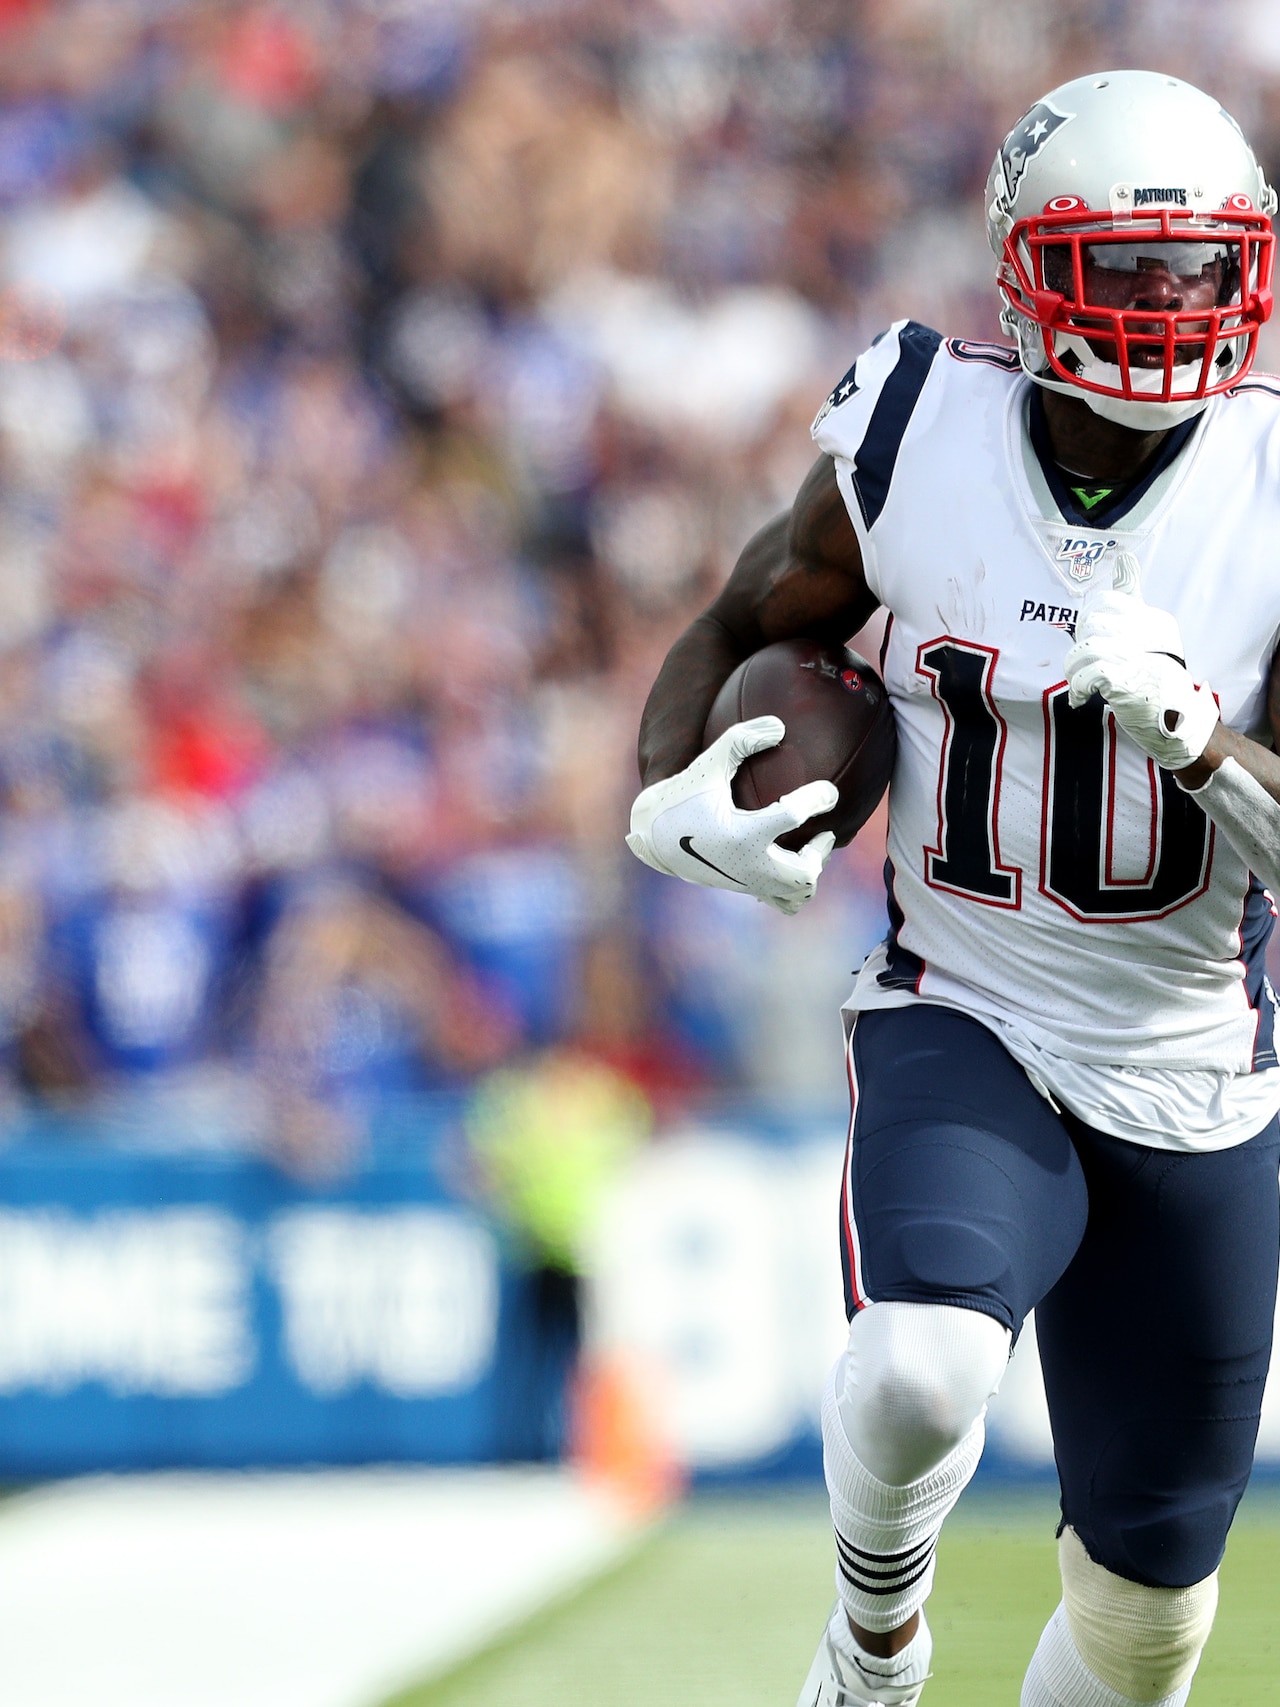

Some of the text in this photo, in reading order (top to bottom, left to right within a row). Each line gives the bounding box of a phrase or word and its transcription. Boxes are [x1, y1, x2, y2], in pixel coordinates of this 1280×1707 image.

[1133, 188, 1187, 207] PATRIOTS
[1073, 564, 1091, 576] NFL
[1019, 599, 1080, 622] PATRI
[915, 634, 1221, 924] 10
